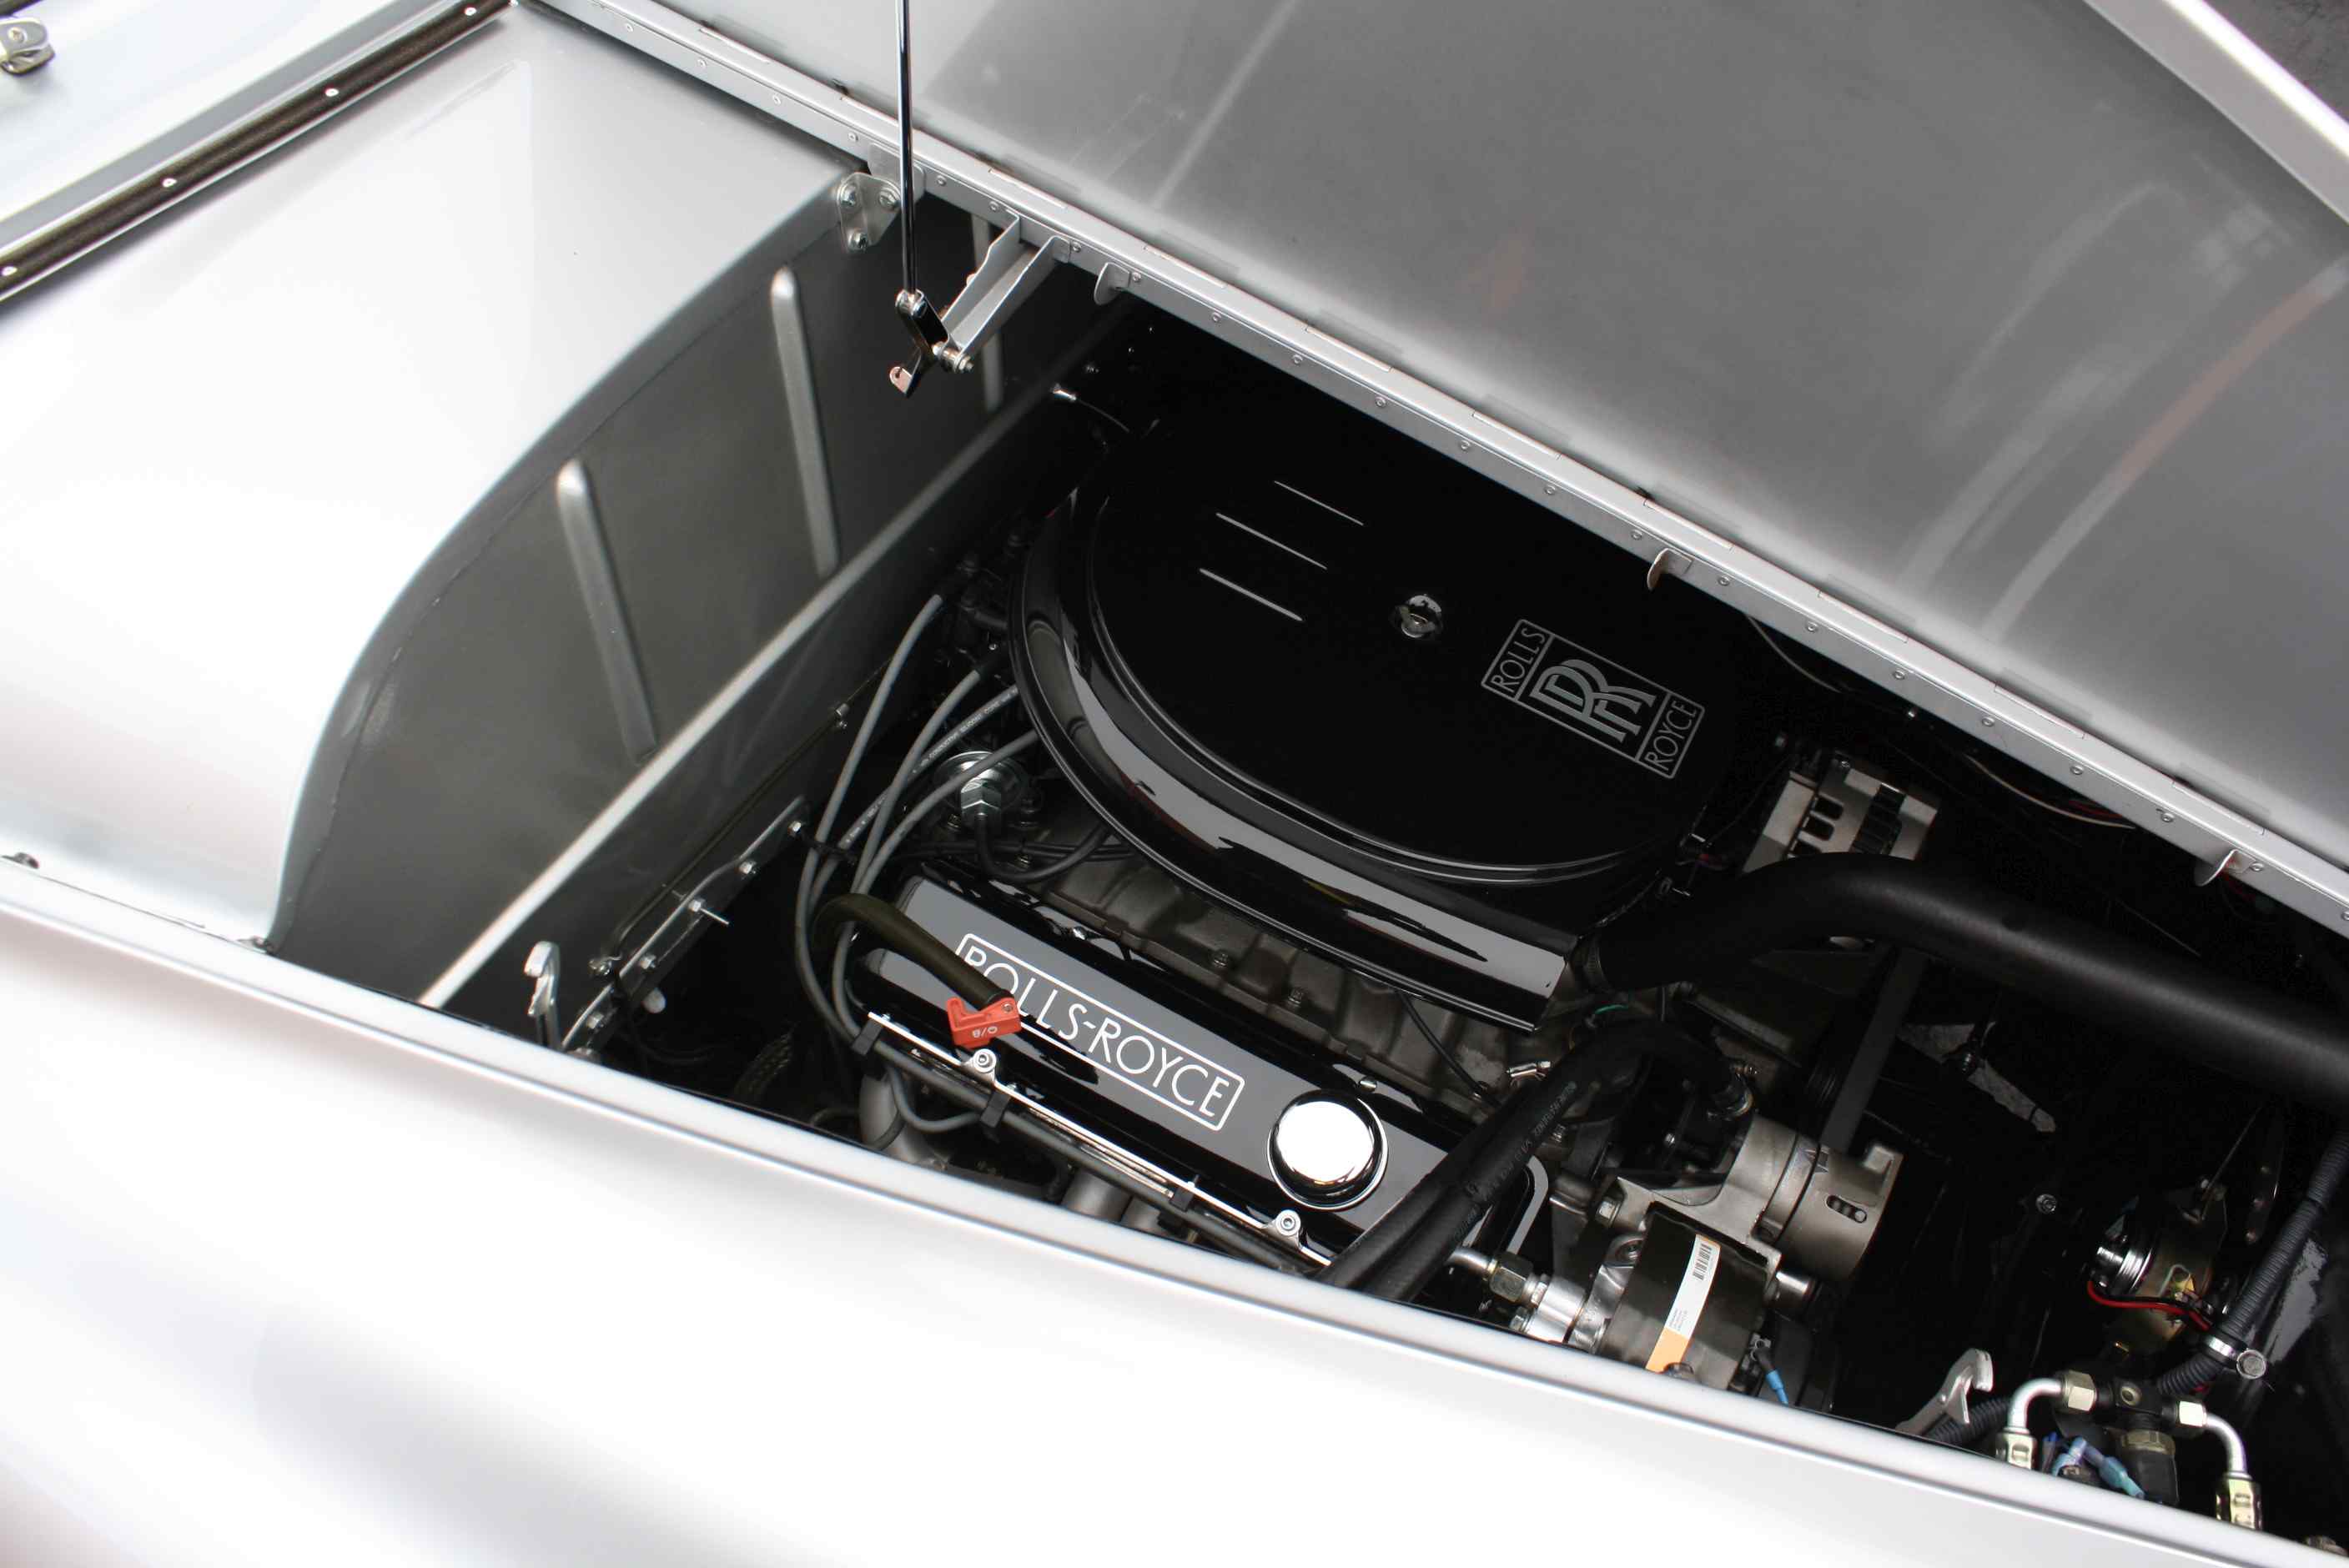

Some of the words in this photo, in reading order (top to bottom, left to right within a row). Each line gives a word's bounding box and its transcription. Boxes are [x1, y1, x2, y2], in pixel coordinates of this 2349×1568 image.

[1491, 627, 1544, 694] ROLLS
[1529, 659, 1657, 743] RR
[1644, 700, 1697, 771] ROYCE
